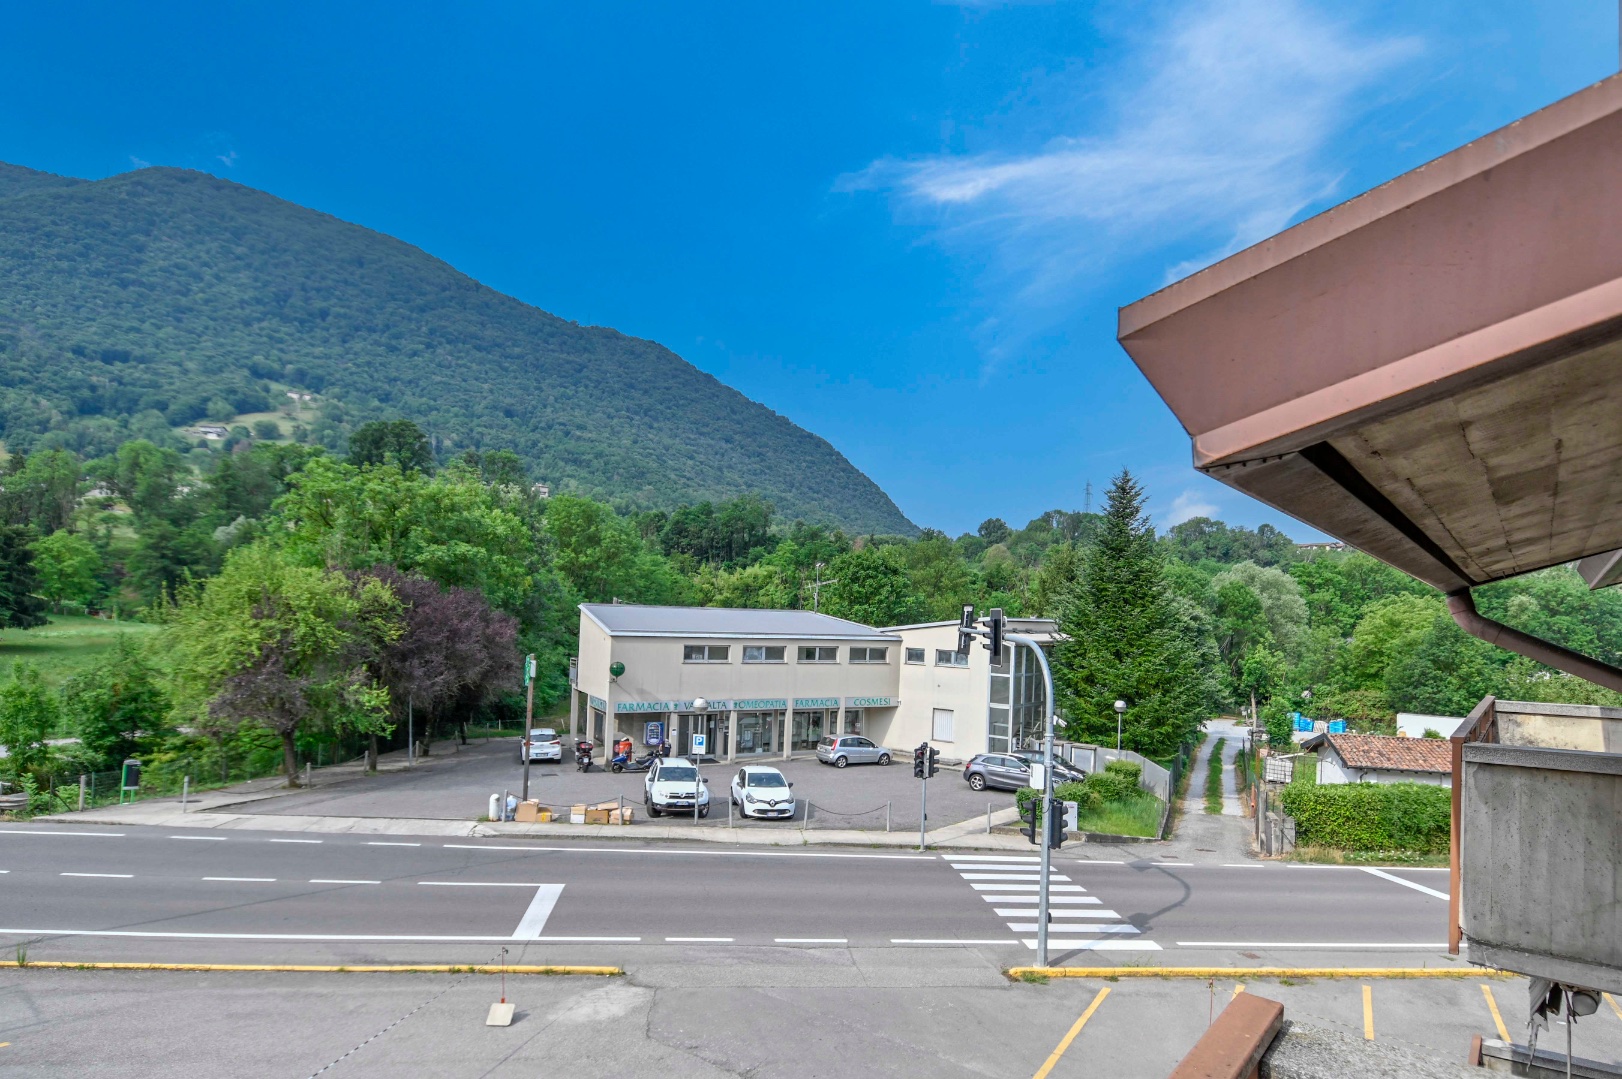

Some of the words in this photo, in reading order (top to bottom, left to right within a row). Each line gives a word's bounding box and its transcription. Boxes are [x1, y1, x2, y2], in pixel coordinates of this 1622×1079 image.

[617, 702, 670, 711] FARMACIA
[684, 701, 727, 710] VAALTA
[738, 699, 787, 709] OMEOPATIA
[795, 698, 839, 708] FARMACIA
[854, 697, 891, 706] COSMESI
[696, 737, 703, 745] P
